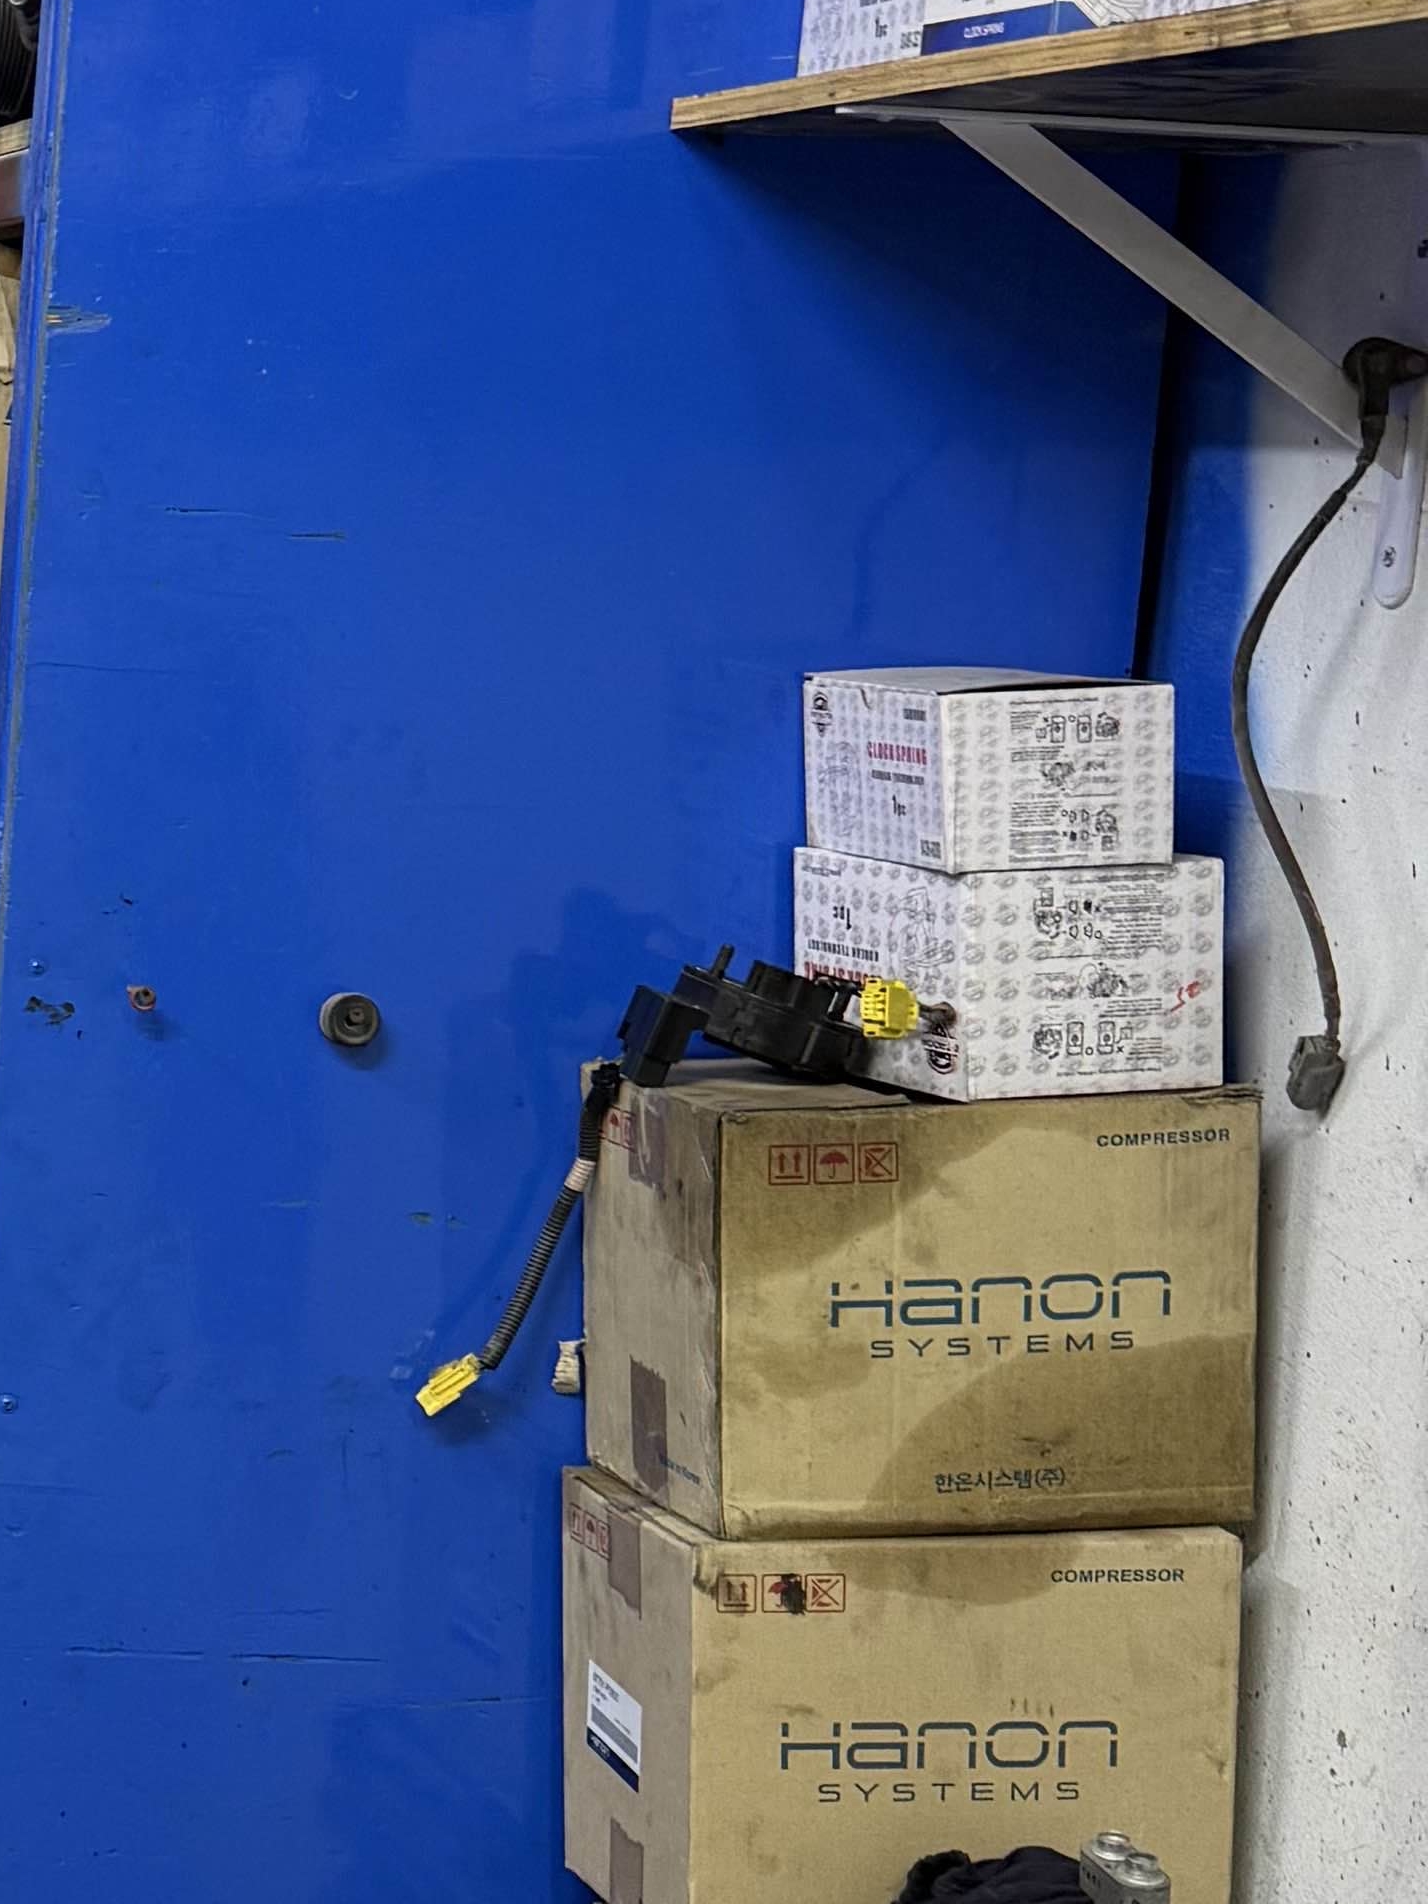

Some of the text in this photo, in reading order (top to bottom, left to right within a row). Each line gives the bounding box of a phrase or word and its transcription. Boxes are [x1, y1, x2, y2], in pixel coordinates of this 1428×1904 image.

[1095, 1126, 1231, 1150] COMPRESSOR
[828, 1268, 1173, 1329] Hanon
[869, 1329, 1136, 1359] SYSTEMS
[932, 1464, 1067, 1495] 한온시스템(주)
[1050, 1567, 1185, 1585] COMPRESSOR
[780, 1719, 1118, 1770] Hanon
[817, 1780, 1081, 1805] SYSTEMS
